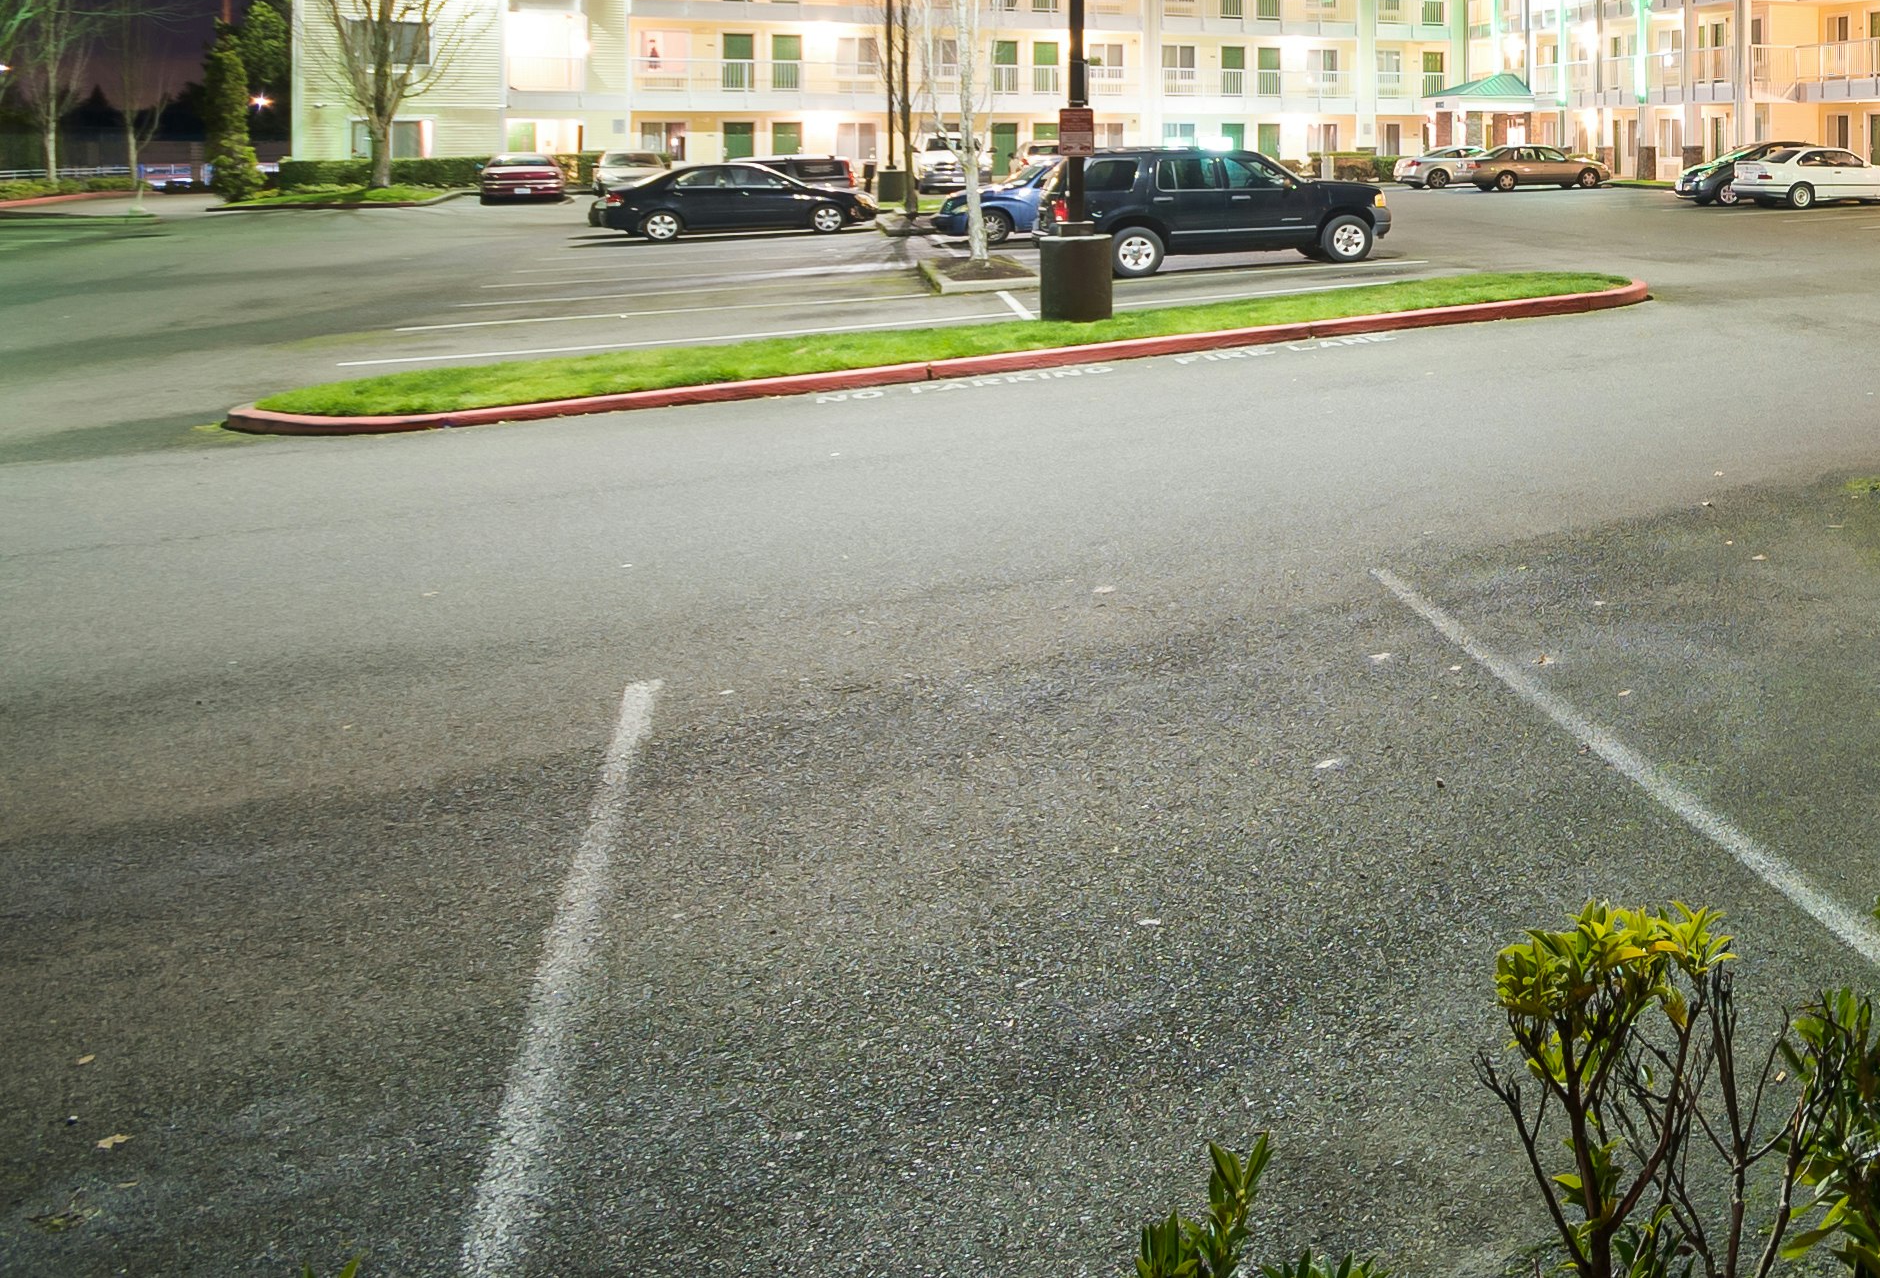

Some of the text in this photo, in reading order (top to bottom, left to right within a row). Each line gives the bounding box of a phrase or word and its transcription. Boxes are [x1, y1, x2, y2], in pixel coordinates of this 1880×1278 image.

[1174, 334, 1397, 365] FIRE LANE
[815, 366, 1115, 404] NO PARKING
